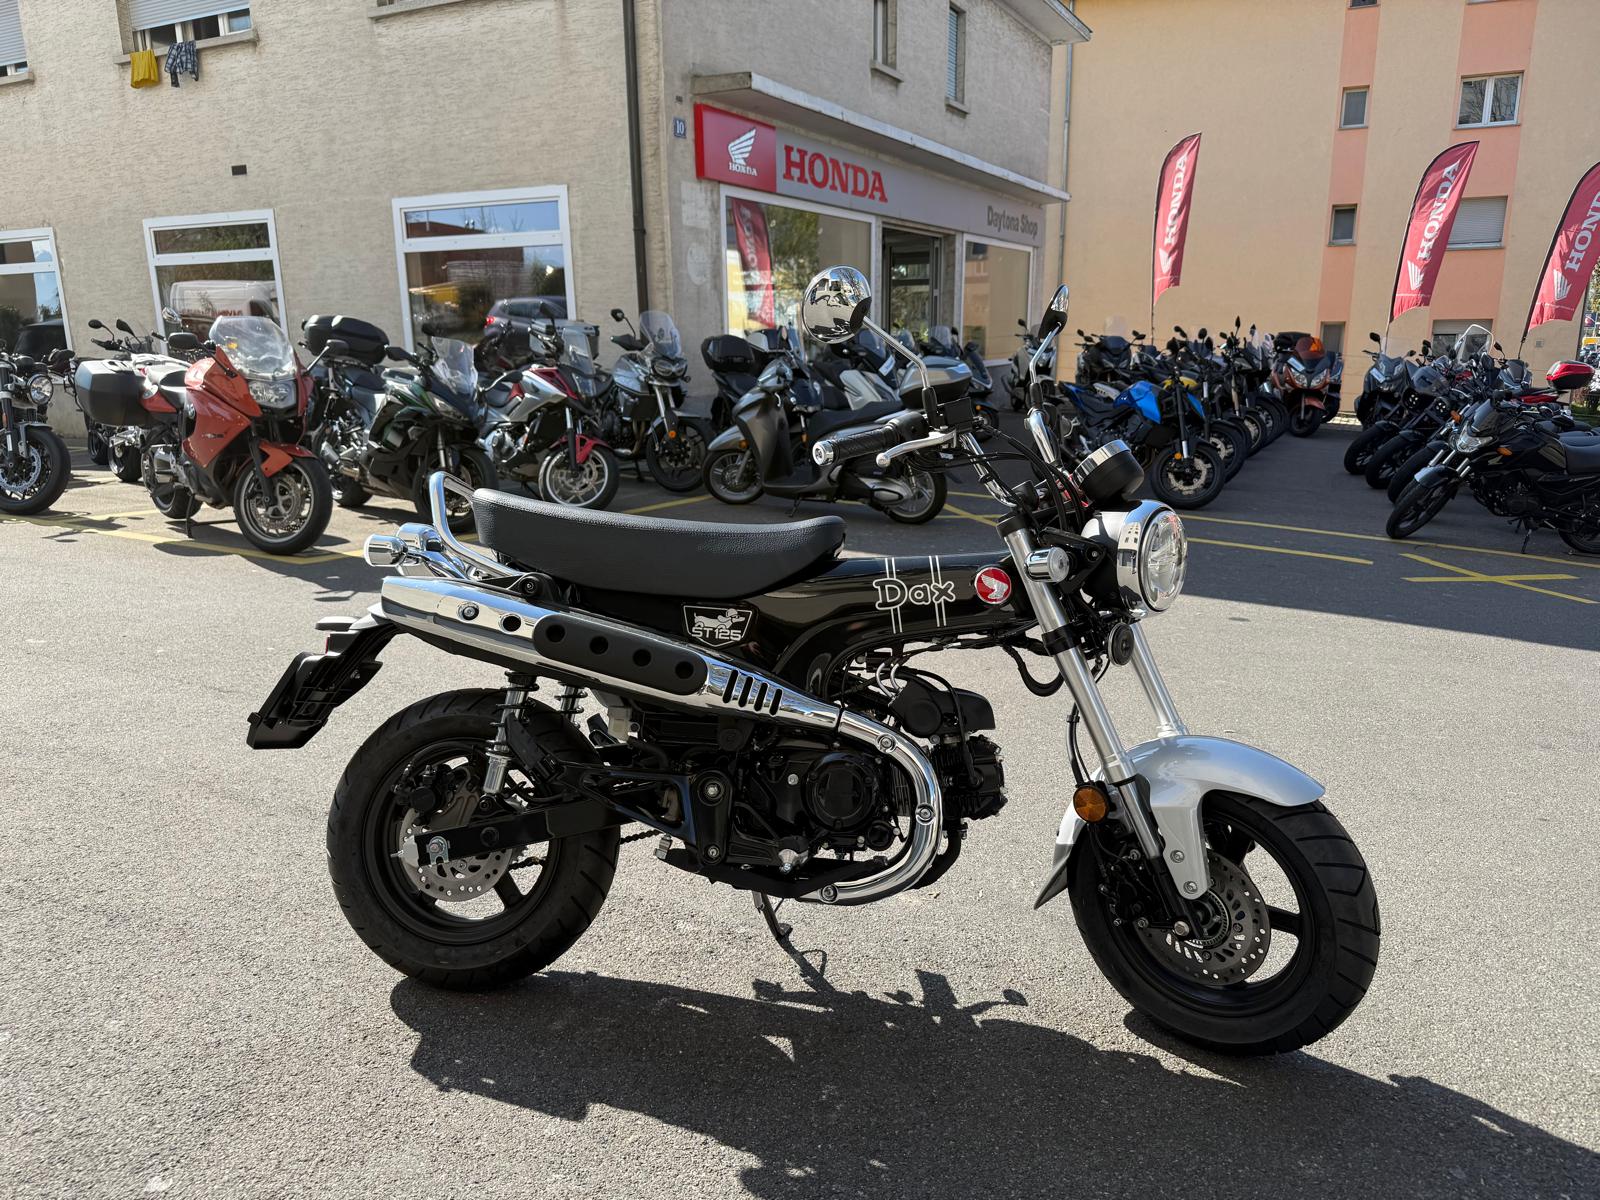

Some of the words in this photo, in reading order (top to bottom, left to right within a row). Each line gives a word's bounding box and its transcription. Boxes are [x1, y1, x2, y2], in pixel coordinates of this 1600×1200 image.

[676, 120, 685, 135] 10
[728, 161, 758, 177] HONDA
[783, 144, 888, 203] HONDA
[1164, 154, 1187, 247] HONDA
[1416, 159, 1460, 261] HONDA
[987, 205, 1019, 233] Daytona
[1020, 214, 1038, 241] Shop
[872, 578, 956, 610] Dax
